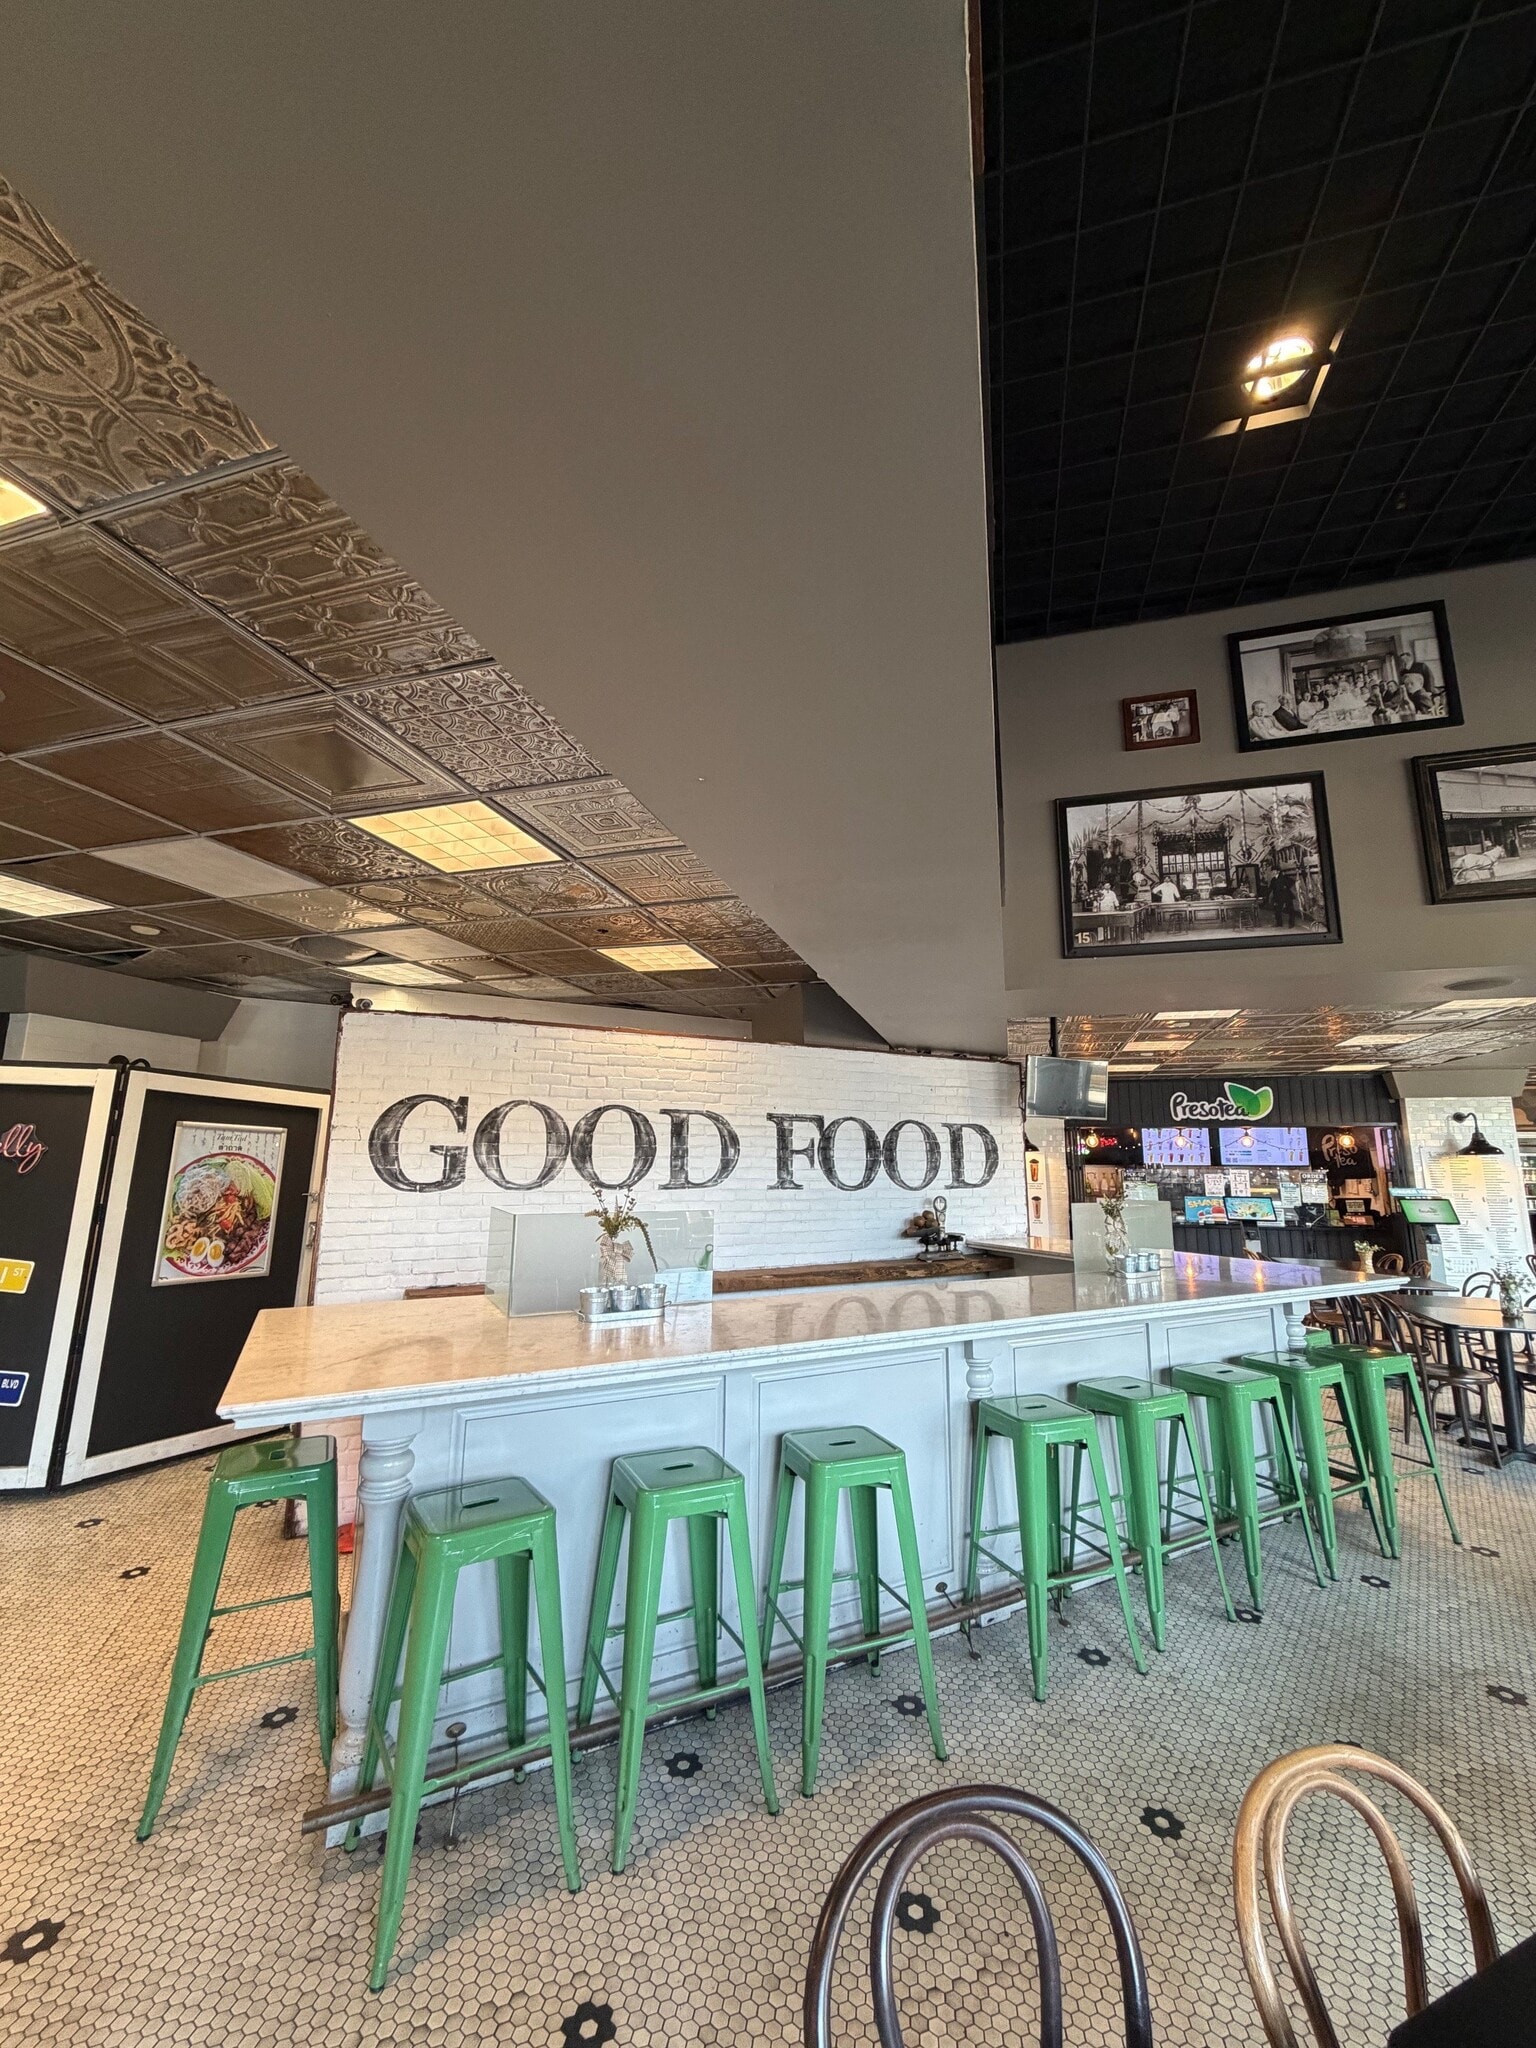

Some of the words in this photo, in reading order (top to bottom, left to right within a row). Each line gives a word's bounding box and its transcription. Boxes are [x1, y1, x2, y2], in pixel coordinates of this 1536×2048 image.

[1428, 705, 1446, 716] 16
[1132, 731, 1147, 742] 14
[1075, 931, 1091, 944] 15
[1171, 1094, 1250, 1119] Presotea
[0, 1124, 46, 1173] lly
[368, 1093, 740, 1193] GOOD
[766, 1111, 999, 1192] FOOD
[13, 1267, 25, 1277] ST
[1, 1378, 20, 1390] BLVD
